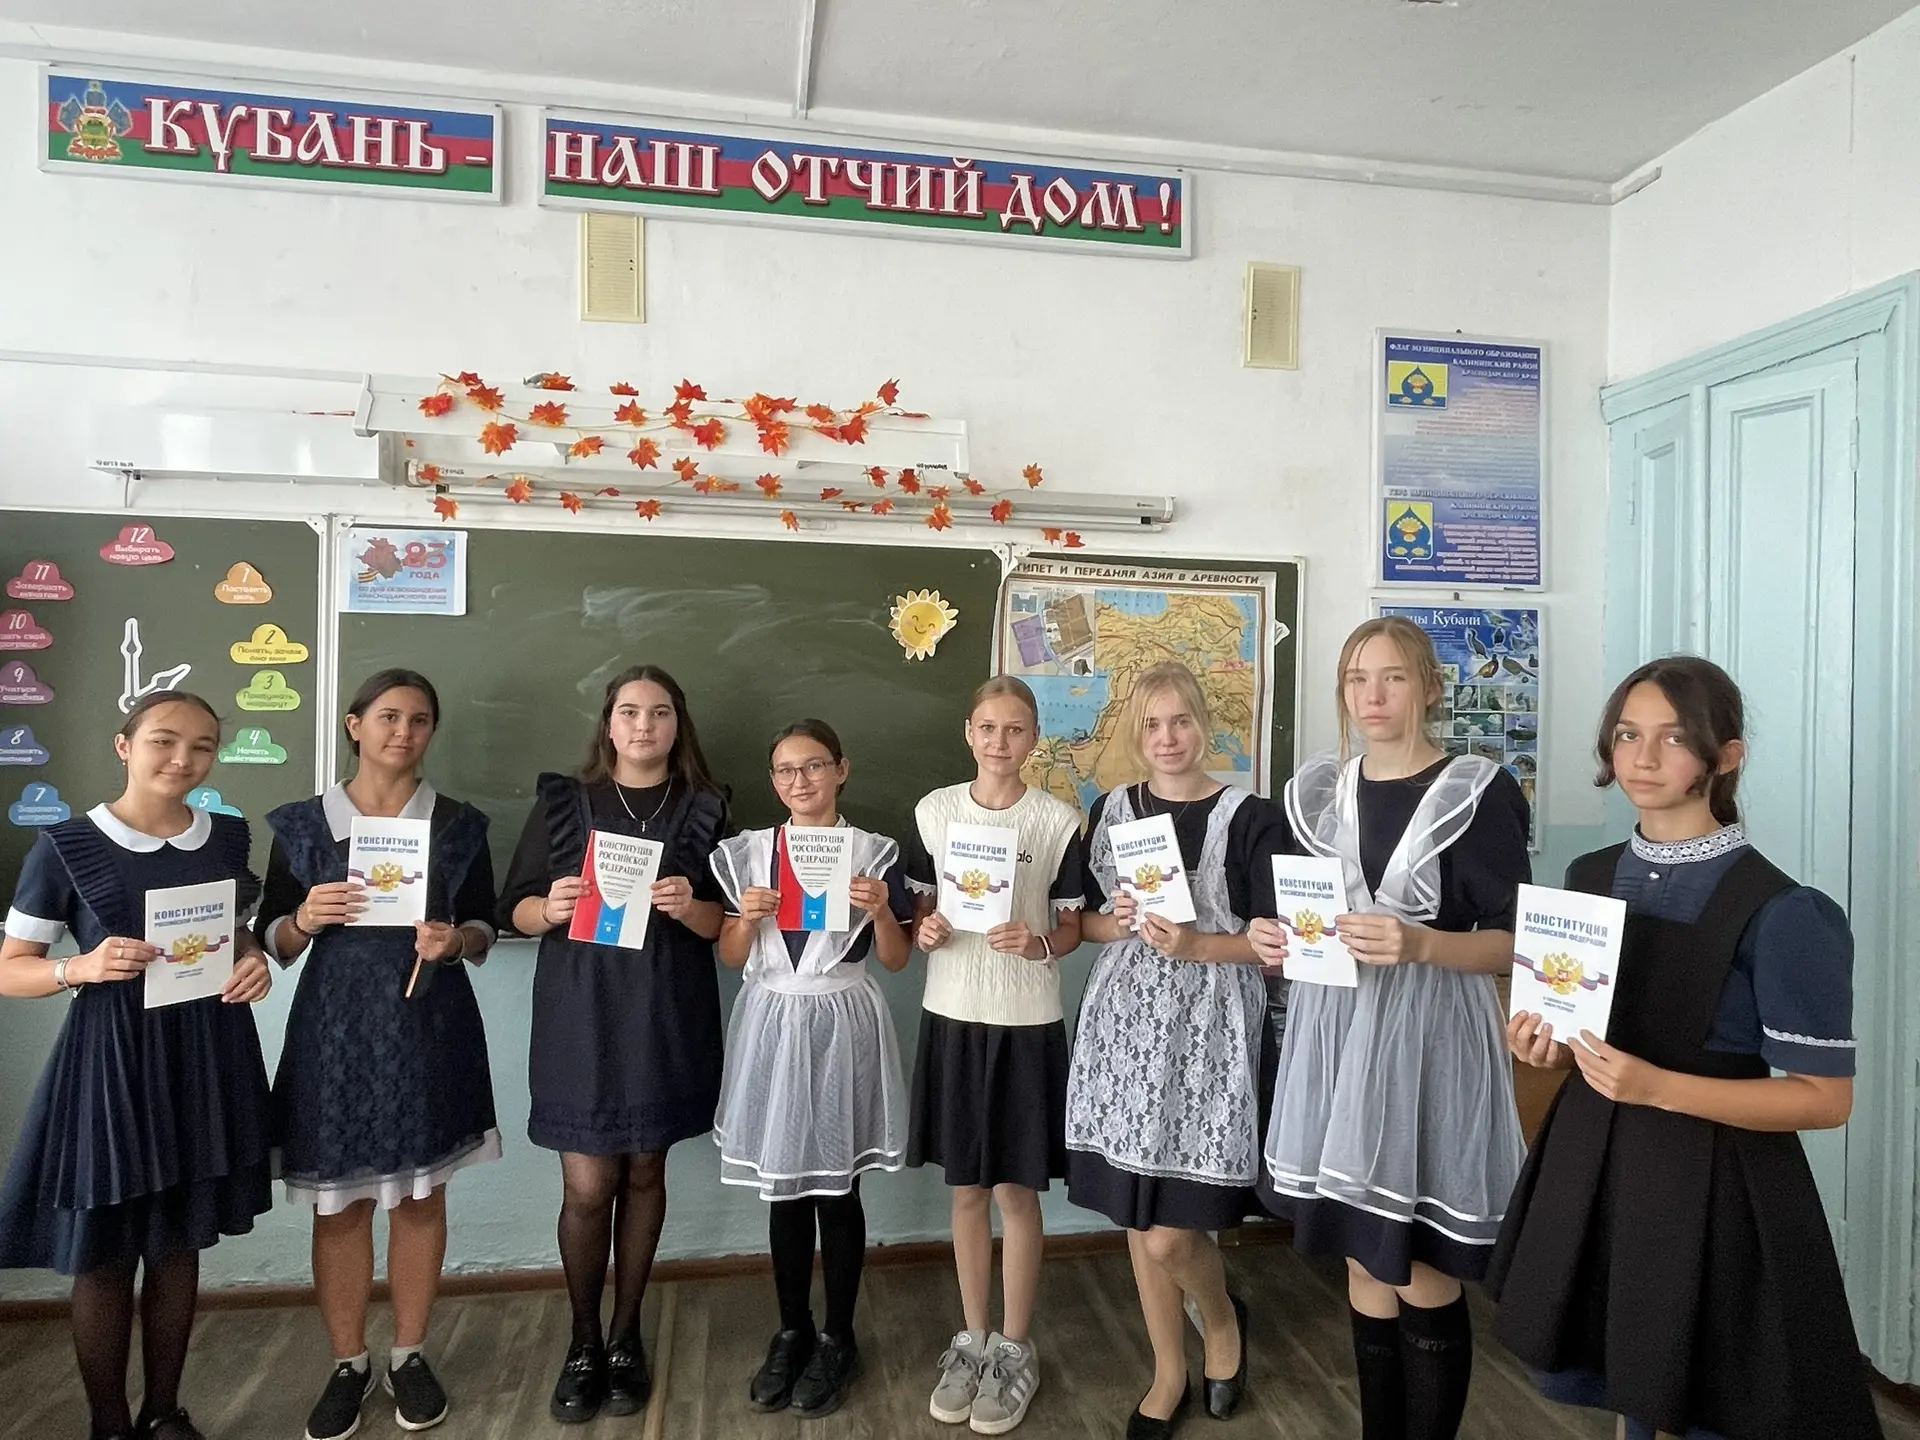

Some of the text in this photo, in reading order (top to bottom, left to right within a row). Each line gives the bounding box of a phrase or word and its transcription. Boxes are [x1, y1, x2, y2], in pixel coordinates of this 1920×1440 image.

[144, 97, 446, 173] КУБАНЬ
[549, 129, 721, 194] НАШ
[750, 148, 986, 218] ОТЧИЙ
[1512, 361, 1539, 370] РАЙОН
[131, 527, 149, 543] 12
[114, 544, 160, 554] Выбирать
[35, 564, 50, 580] 11
[242, 567, 250, 583] 1
[409, 571, 440, 579] ГОДА
[1012, 563, 1260, 585] ГИПЕТ И ПЕРЕДНЯЯ АЗИЯ В ДРЕВНОСТИ
[15, 581, 68, 592] Завершать
[221, 584, 268, 594] Поставить
[9, 613, 27, 630] 10
[1432, 610, 1481, 627] Кубани
[264, 629, 276, 645] 2
[14, 667, 24, 683] 9
[263, 674, 274, 690] 3
[10, 729, 25, 745] 8
[249, 729, 261, 746] 4
[236, 746, 270, 755] Начать
[35, 787, 47, 802] 7
[198, 791, 210, 808] 5
[358, 836, 419, 847] КОНСТИТУЦИЯ
[790, 833, 845, 844] КОНСТИТУЦИЯ
[1115, 834, 1167, 852] КОНСТИТУЦИЯ
[598, 839, 653, 857] КОНСТИТУЦИЯ
[791, 843, 842, 854] РОССИЙСКОЙ
[951, 840, 1007, 856] КОНСТИТУЦИЯ
[598, 850, 649, 867] РОССИЙСКОЙ
[793, 854, 839, 865] ФЕДЕРАЦИИ
[598, 861, 644, 877] ФЕДЕРАЦИИ
[1279, 878, 1334, 892] КОНСТИТУЦИЯ
[154, 901, 224, 921] КОНСТИТУЦИЯ
[1524, 911, 1609, 938] КОНСТИТУЦИЯ
[1523, 924, 1607, 948] РОССИЙСКОЙ ФЕДЕРАЦИИ
